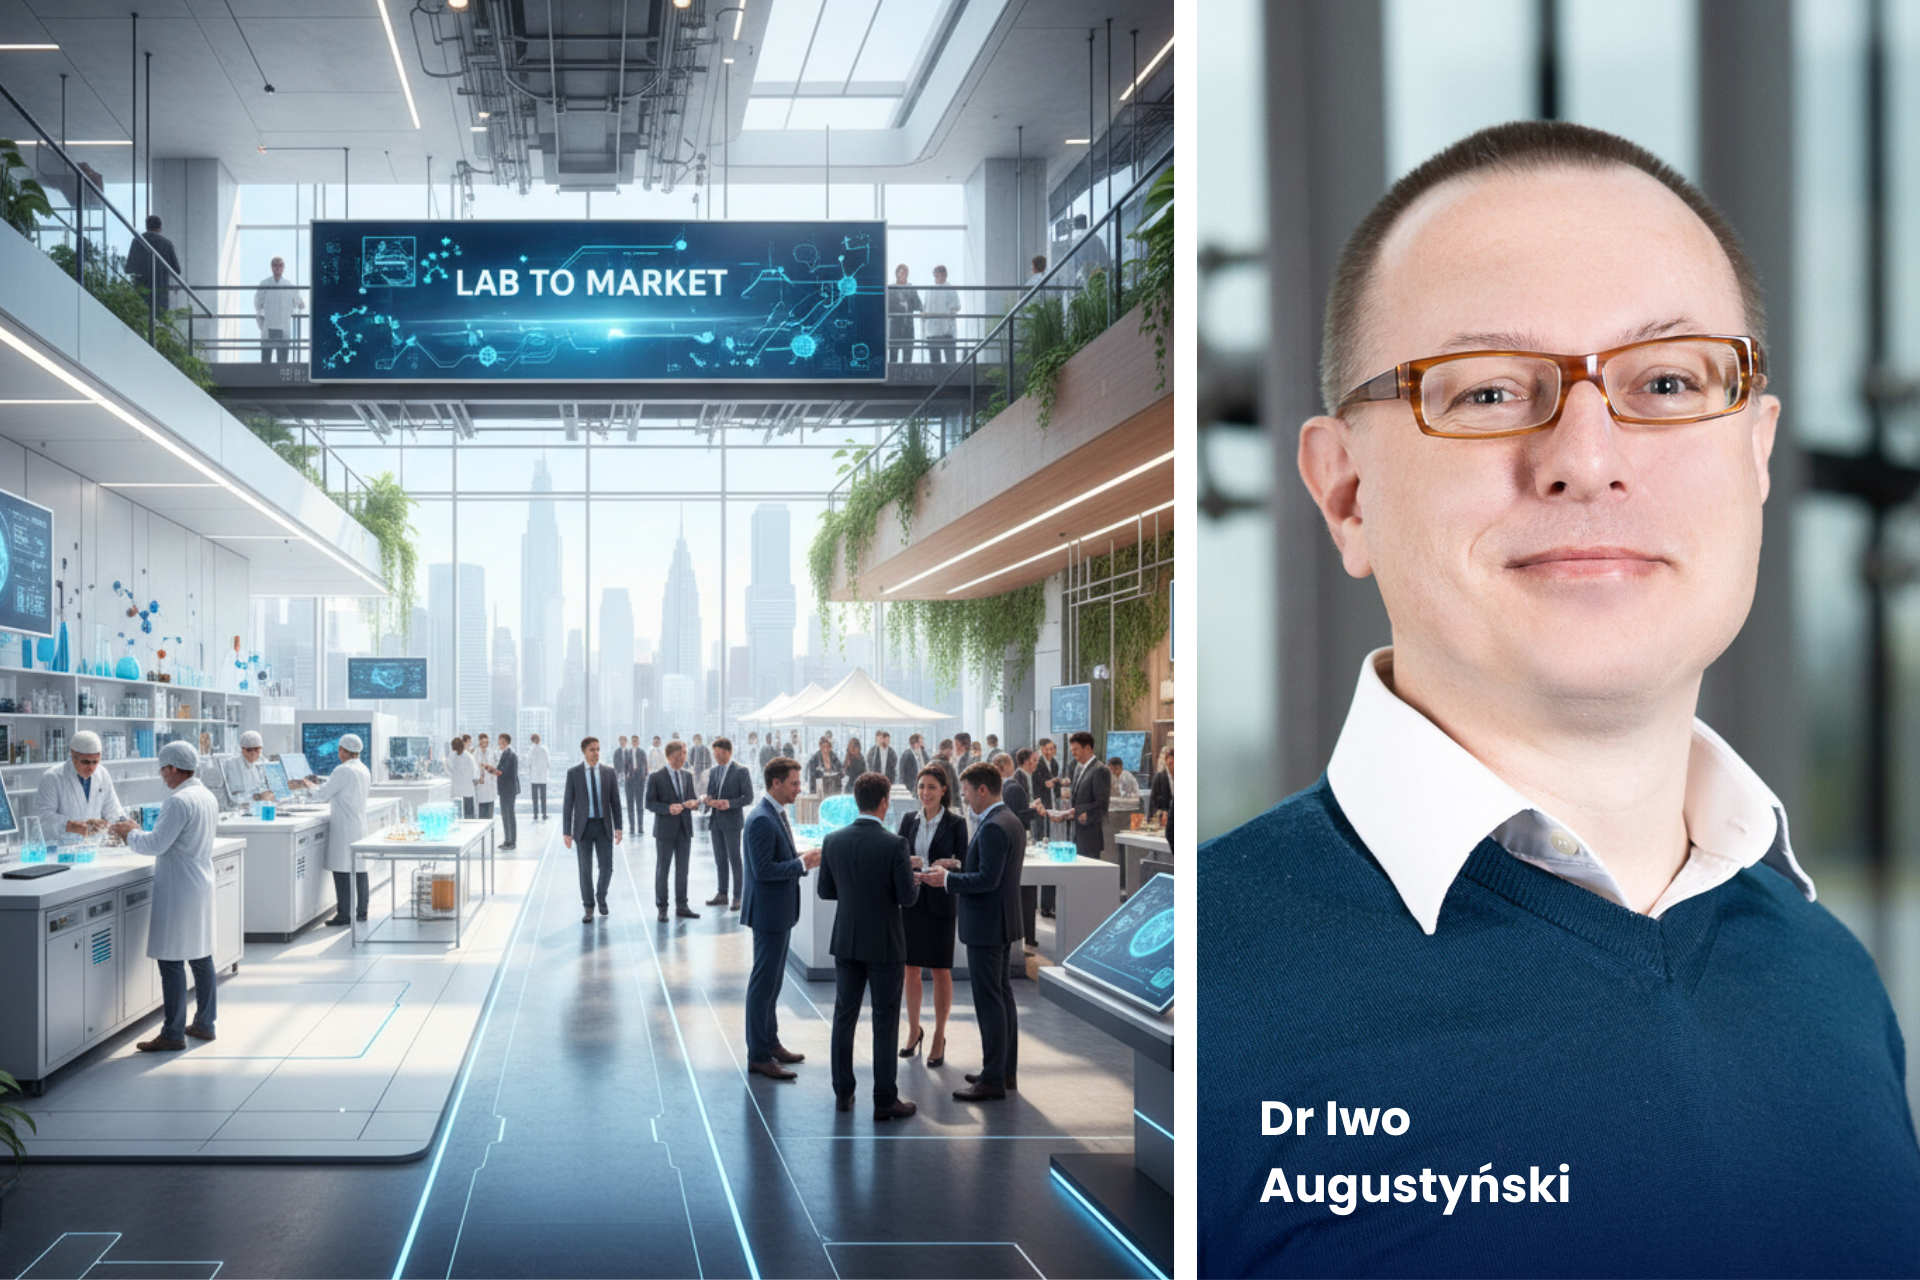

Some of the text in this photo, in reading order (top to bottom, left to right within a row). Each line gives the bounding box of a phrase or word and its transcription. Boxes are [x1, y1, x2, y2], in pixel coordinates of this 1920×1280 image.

[455, 268, 729, 297] LAB TO MARKET
